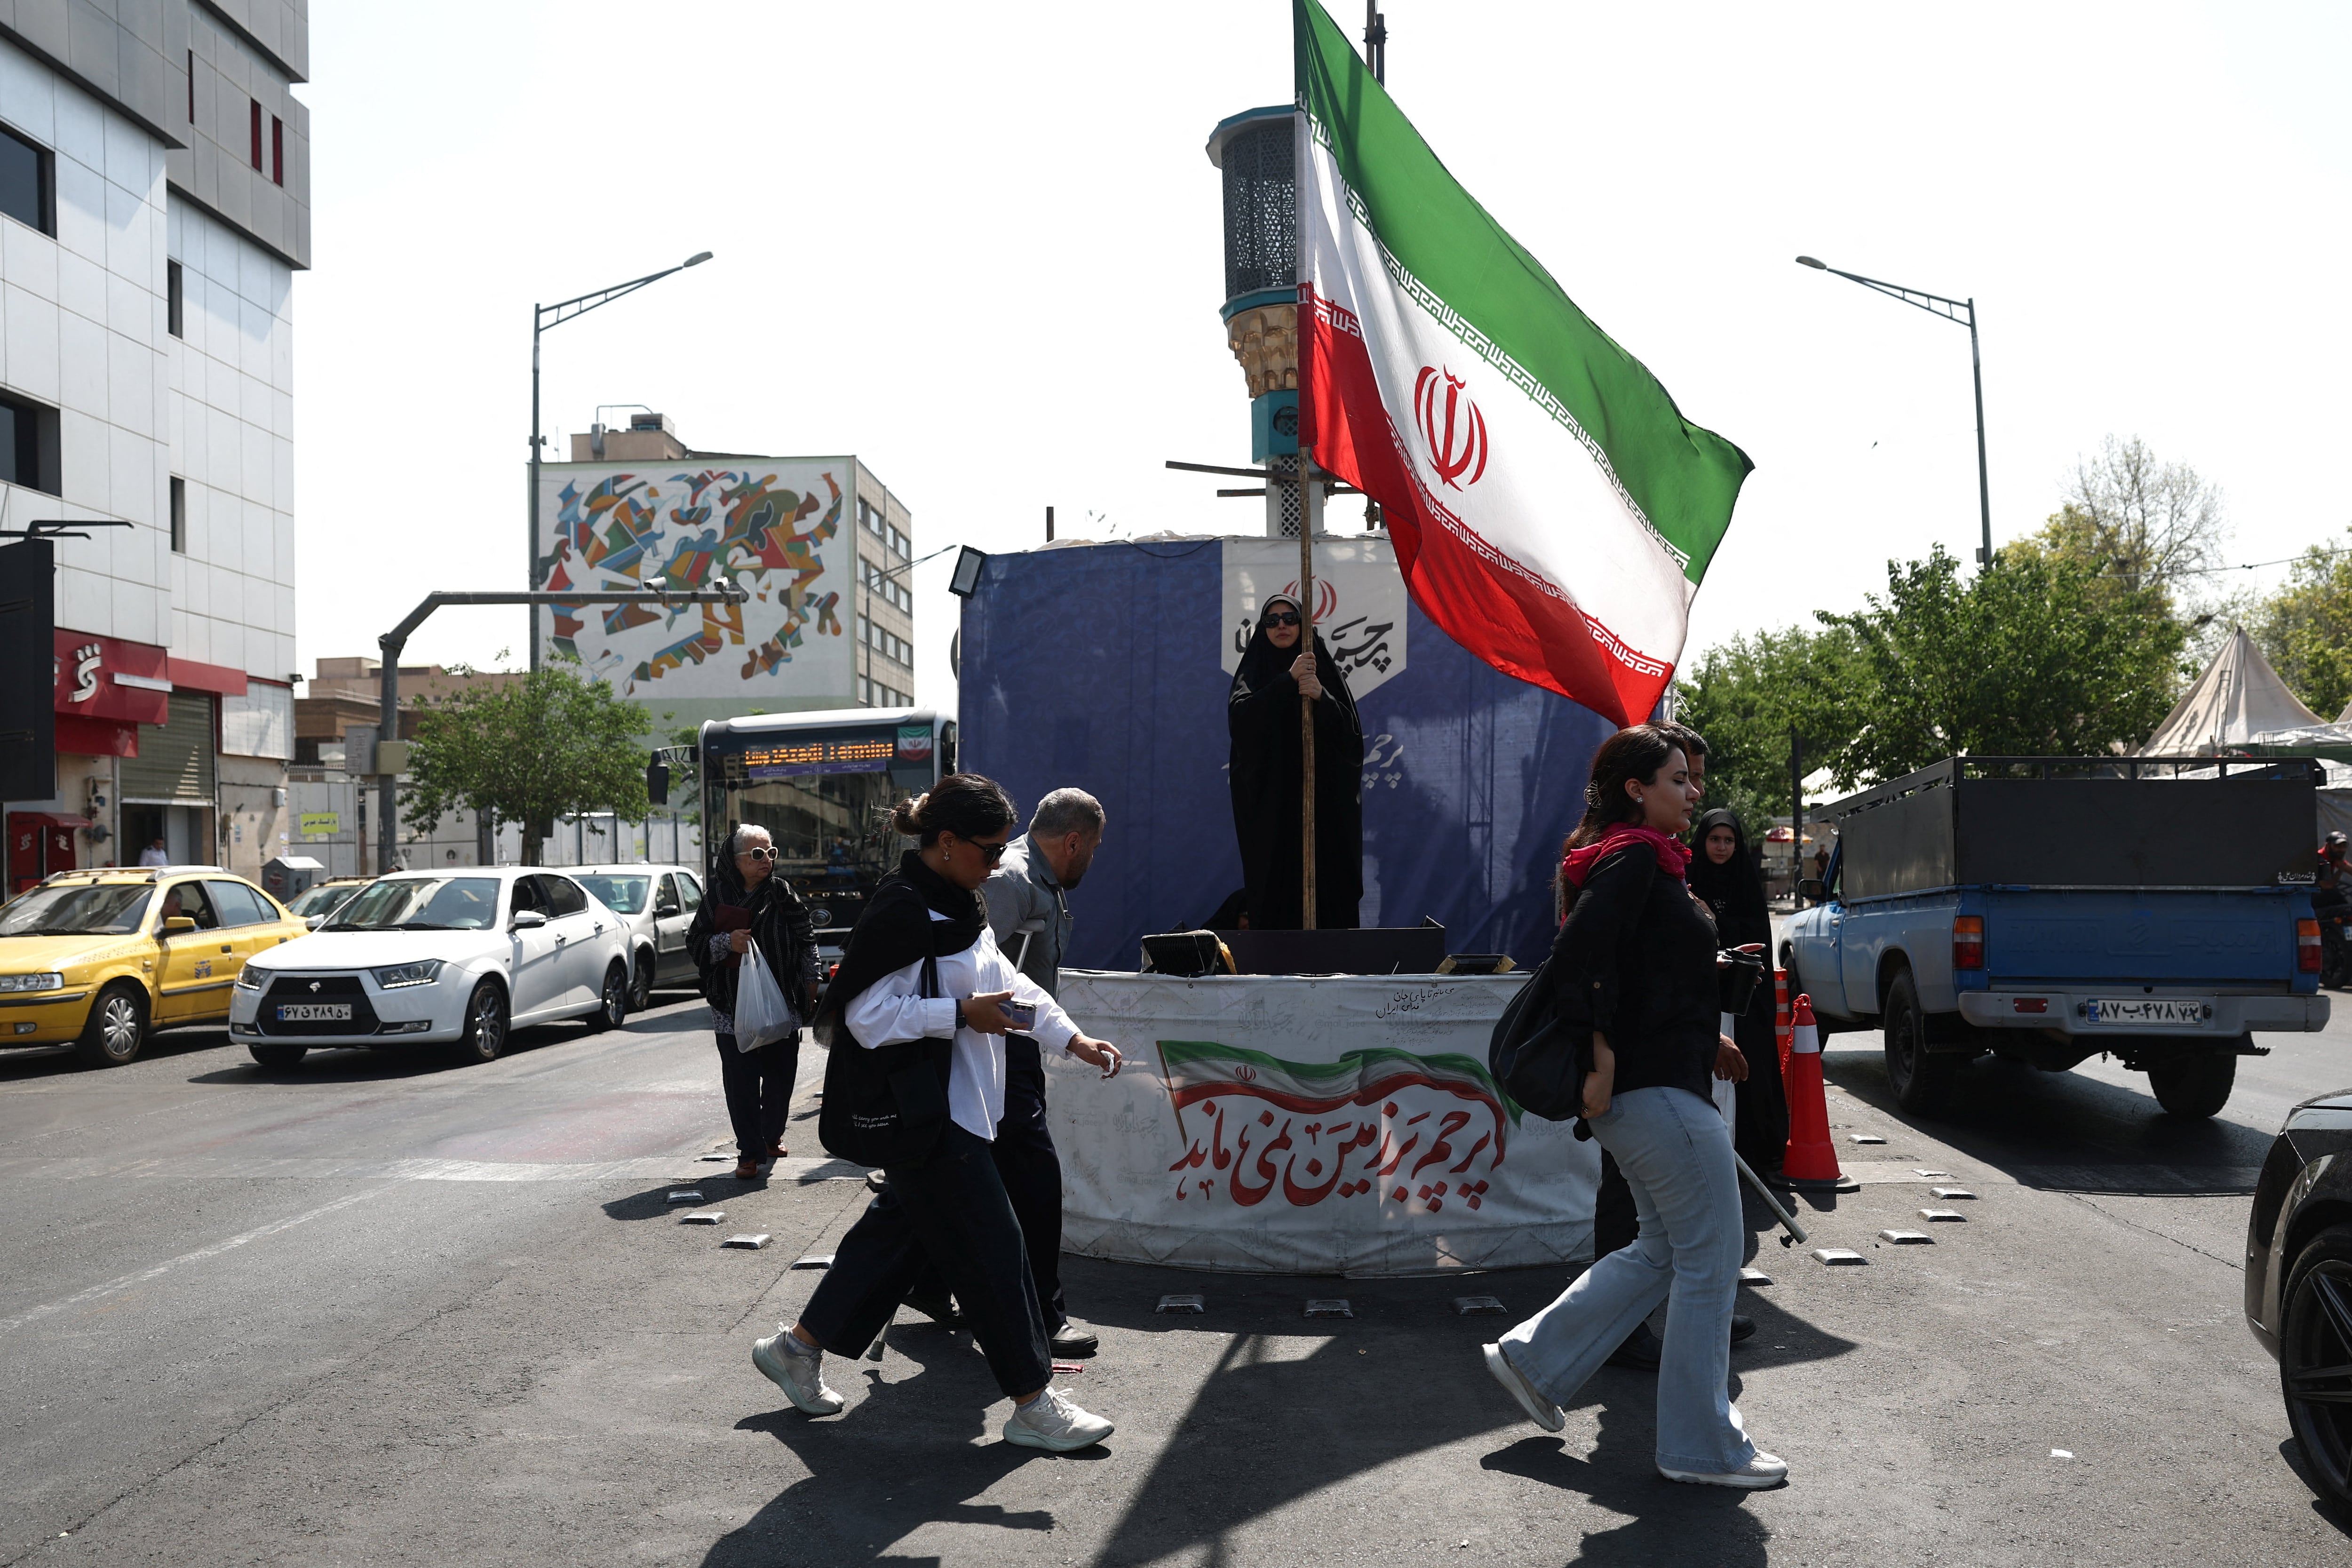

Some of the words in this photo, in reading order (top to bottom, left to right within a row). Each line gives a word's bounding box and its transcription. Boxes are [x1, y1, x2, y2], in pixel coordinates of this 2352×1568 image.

[1393, 989, 1408, 1002] جان
[1427, 989, 1433, 998] تا
[1375, 1003, 1398, 1019] ایران
[1401, 1003, 1420, 1011] فدای
[1168, 1099, 1232, 1171] ماند
[1283, 1101, 1398, 1206] زمین
[1411, 1111, 1490, 1213] پرچم
